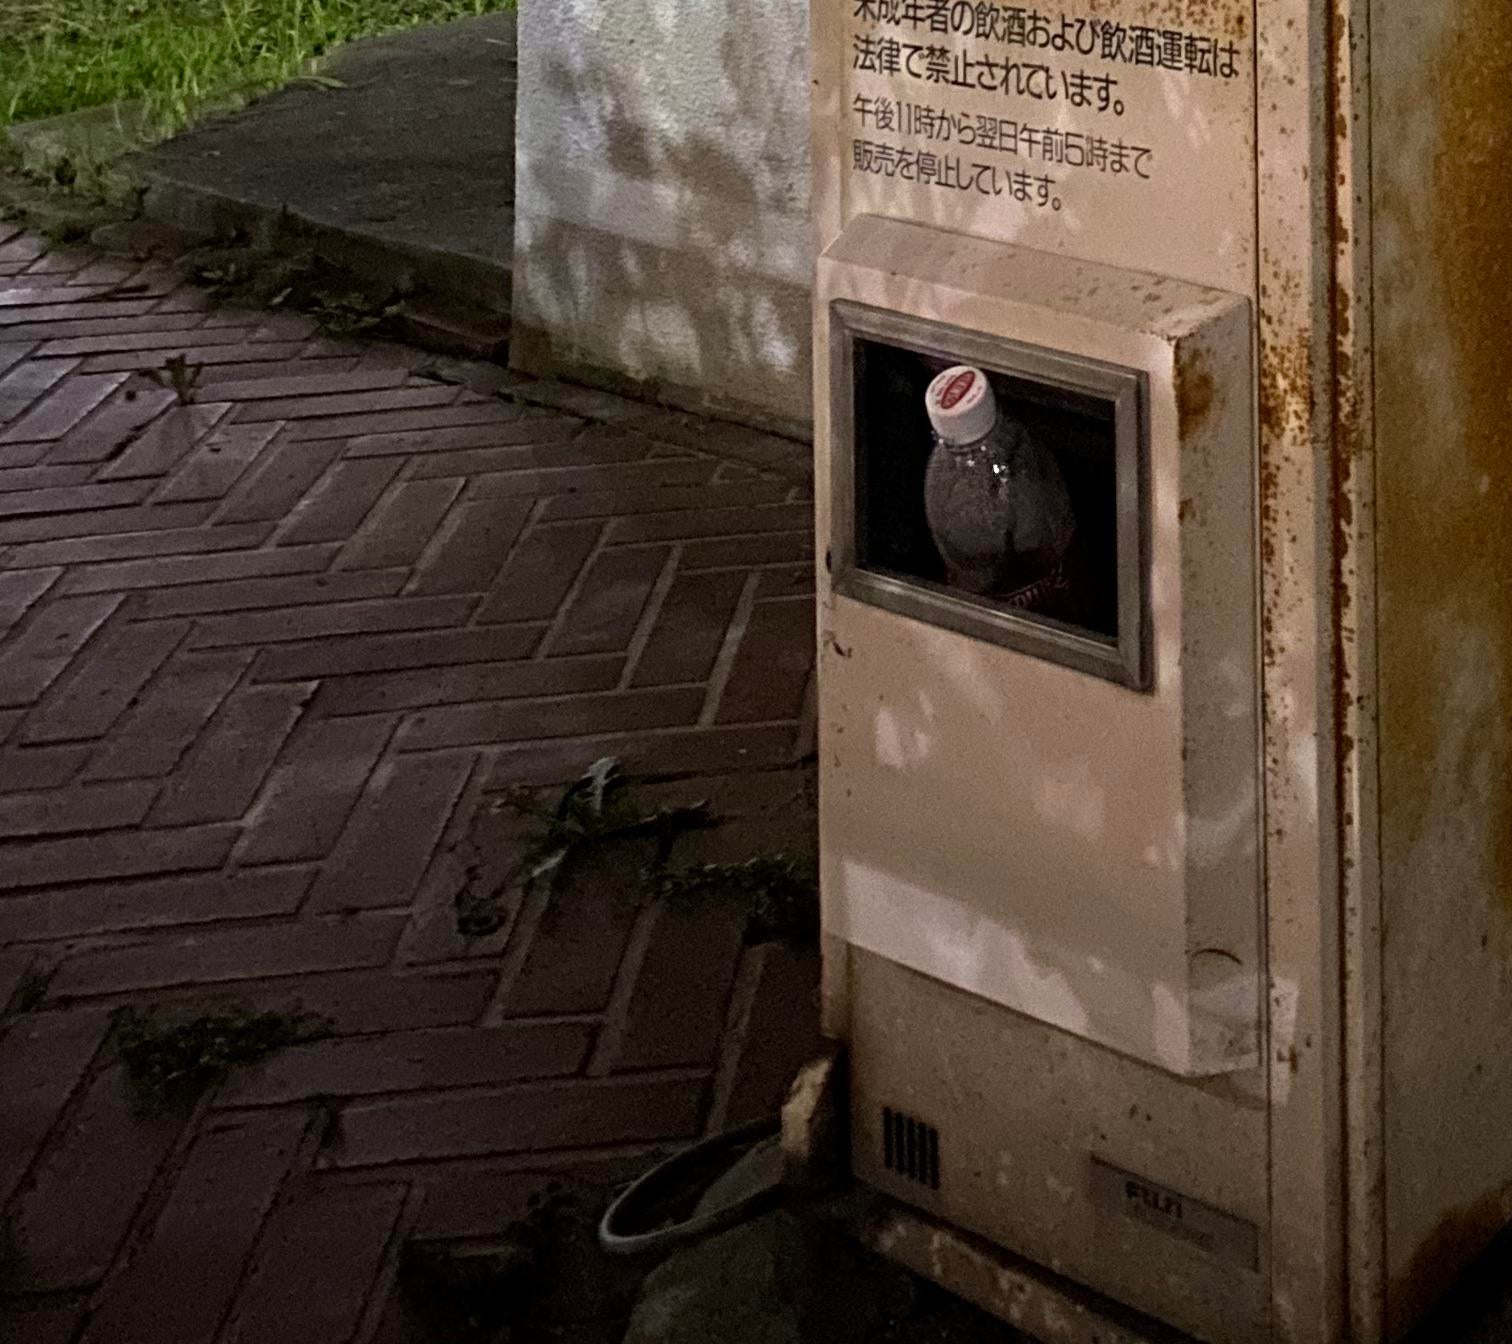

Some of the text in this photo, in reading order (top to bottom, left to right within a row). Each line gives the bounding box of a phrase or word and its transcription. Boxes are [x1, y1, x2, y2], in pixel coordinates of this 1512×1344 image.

[852, 34, 1126, 116] 法律で禁止されています。
[852, 93, 1154, 180] 午後11時から翌日午前5時まで
[852, 140, 1063, 212] 販売を停止しています。
